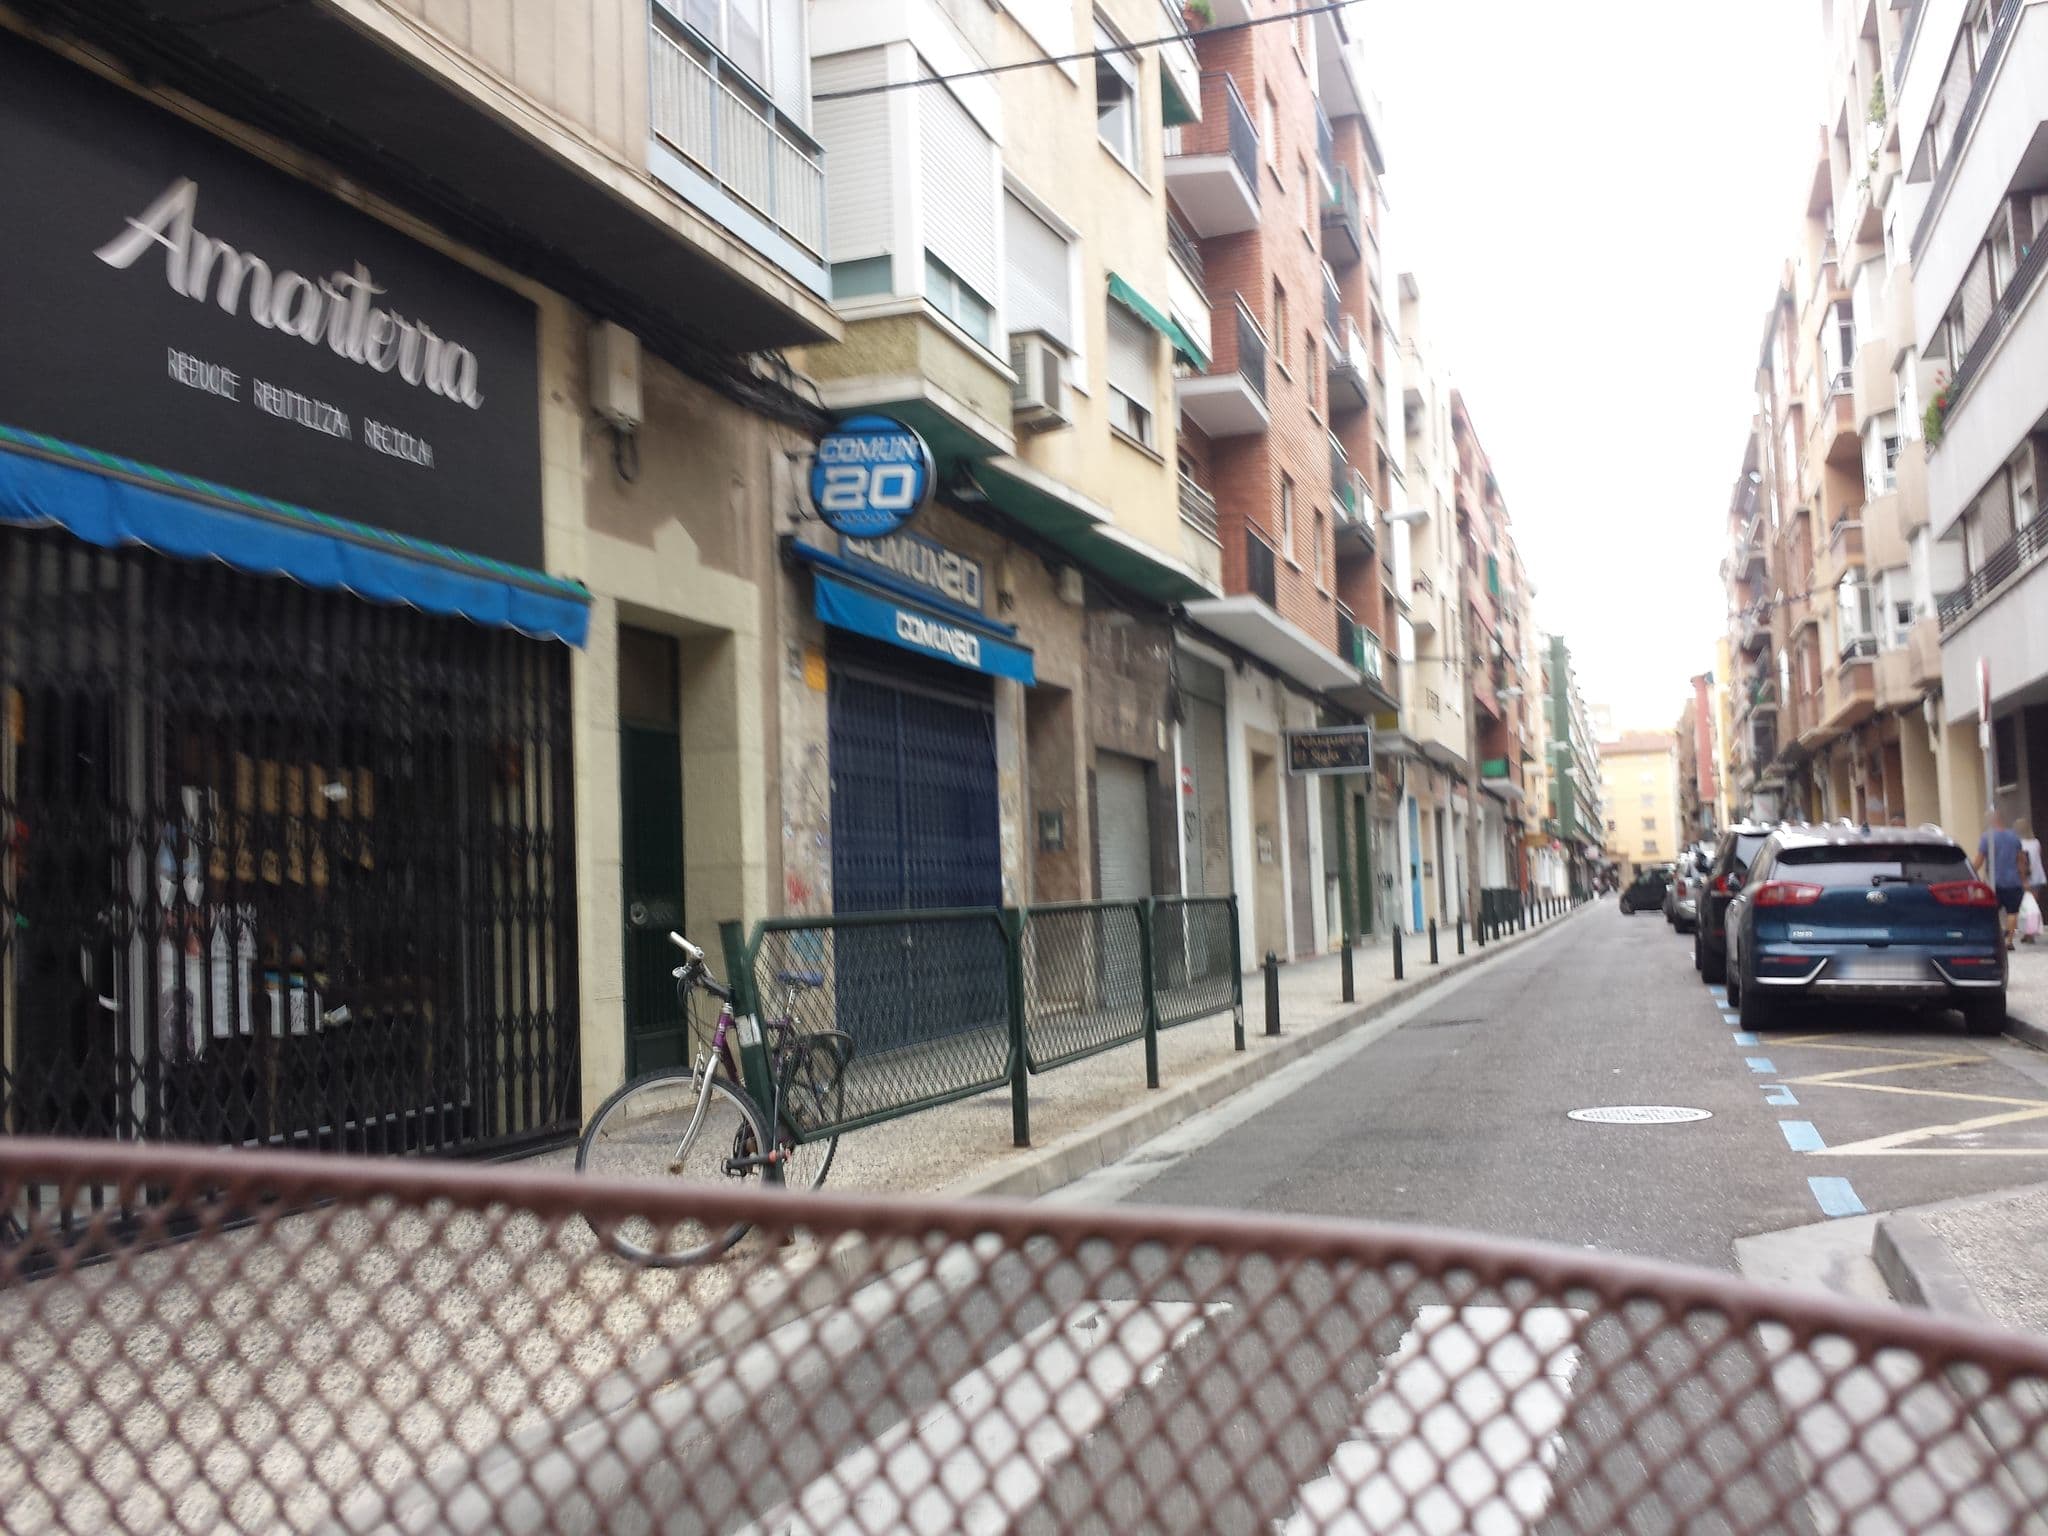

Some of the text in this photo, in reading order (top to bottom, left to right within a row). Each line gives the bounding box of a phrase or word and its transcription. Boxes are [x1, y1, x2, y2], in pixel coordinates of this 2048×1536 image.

[168, 347, 434, 468] REDUCE REUTILIZA RECICLA
[819, 436, 919, 463] COMUN
[821, 464, 917, 511] 20
[896, 610, 981, 667] COMUN20
